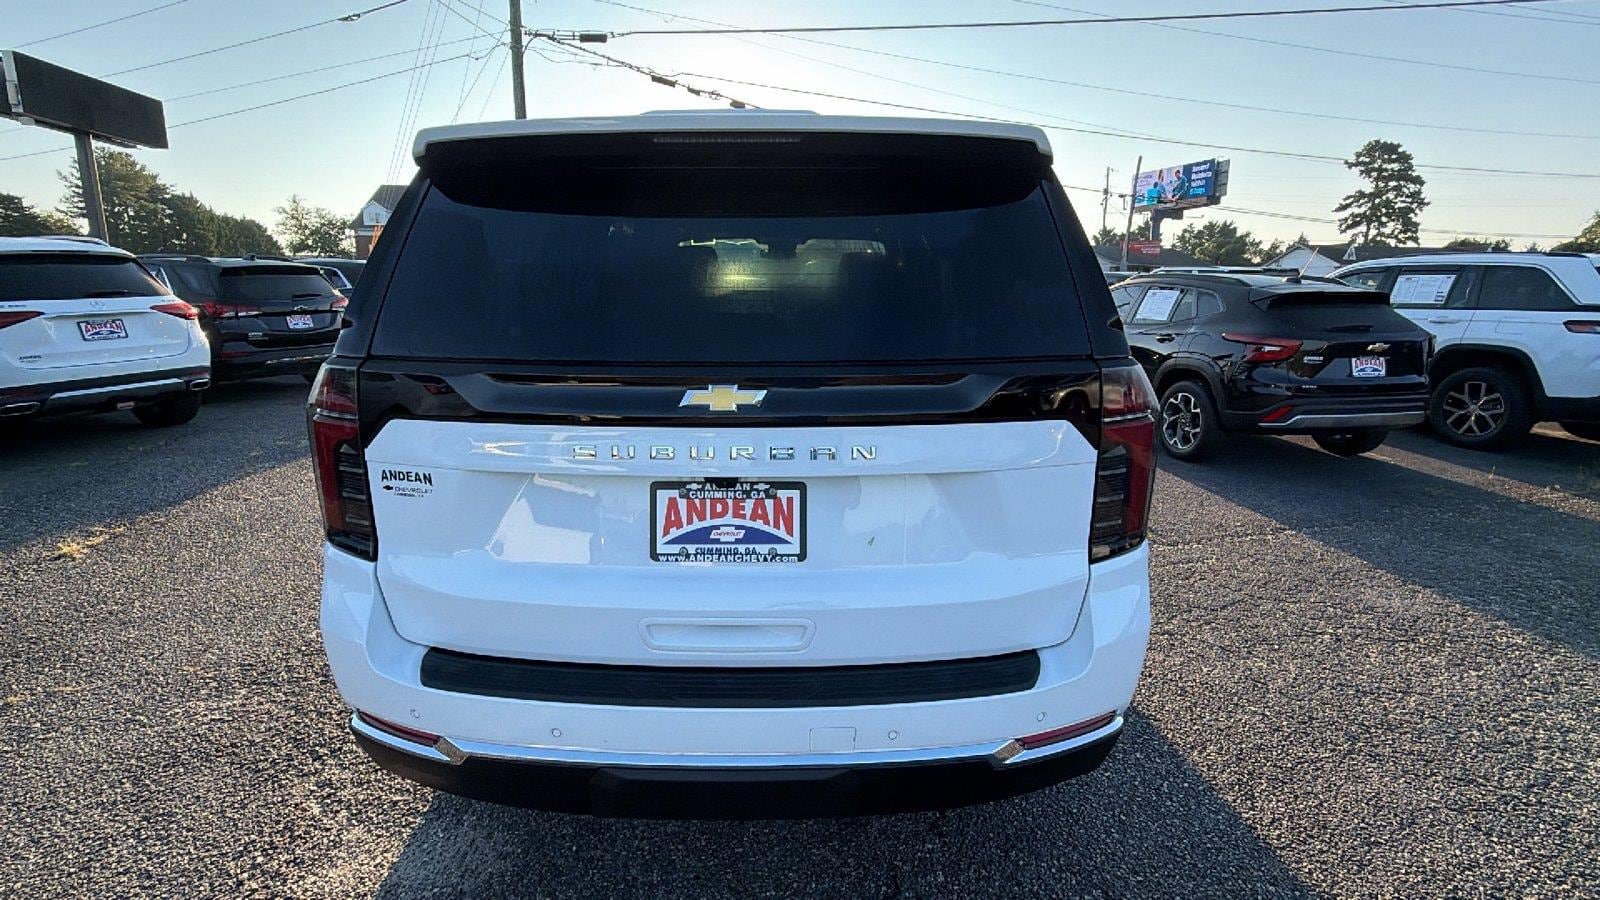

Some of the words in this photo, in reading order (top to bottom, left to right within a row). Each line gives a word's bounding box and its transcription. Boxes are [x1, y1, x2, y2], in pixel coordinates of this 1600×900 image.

[572, 445, 877, 460] SUBURBAN
[381, 469, 433, 486] ANDEAN
[751, 491, 766, 499] GA
[662, 496, 794, 538] ANDEAN
[658, 554, 798, 563] www.ANDEANCHEVY.com
